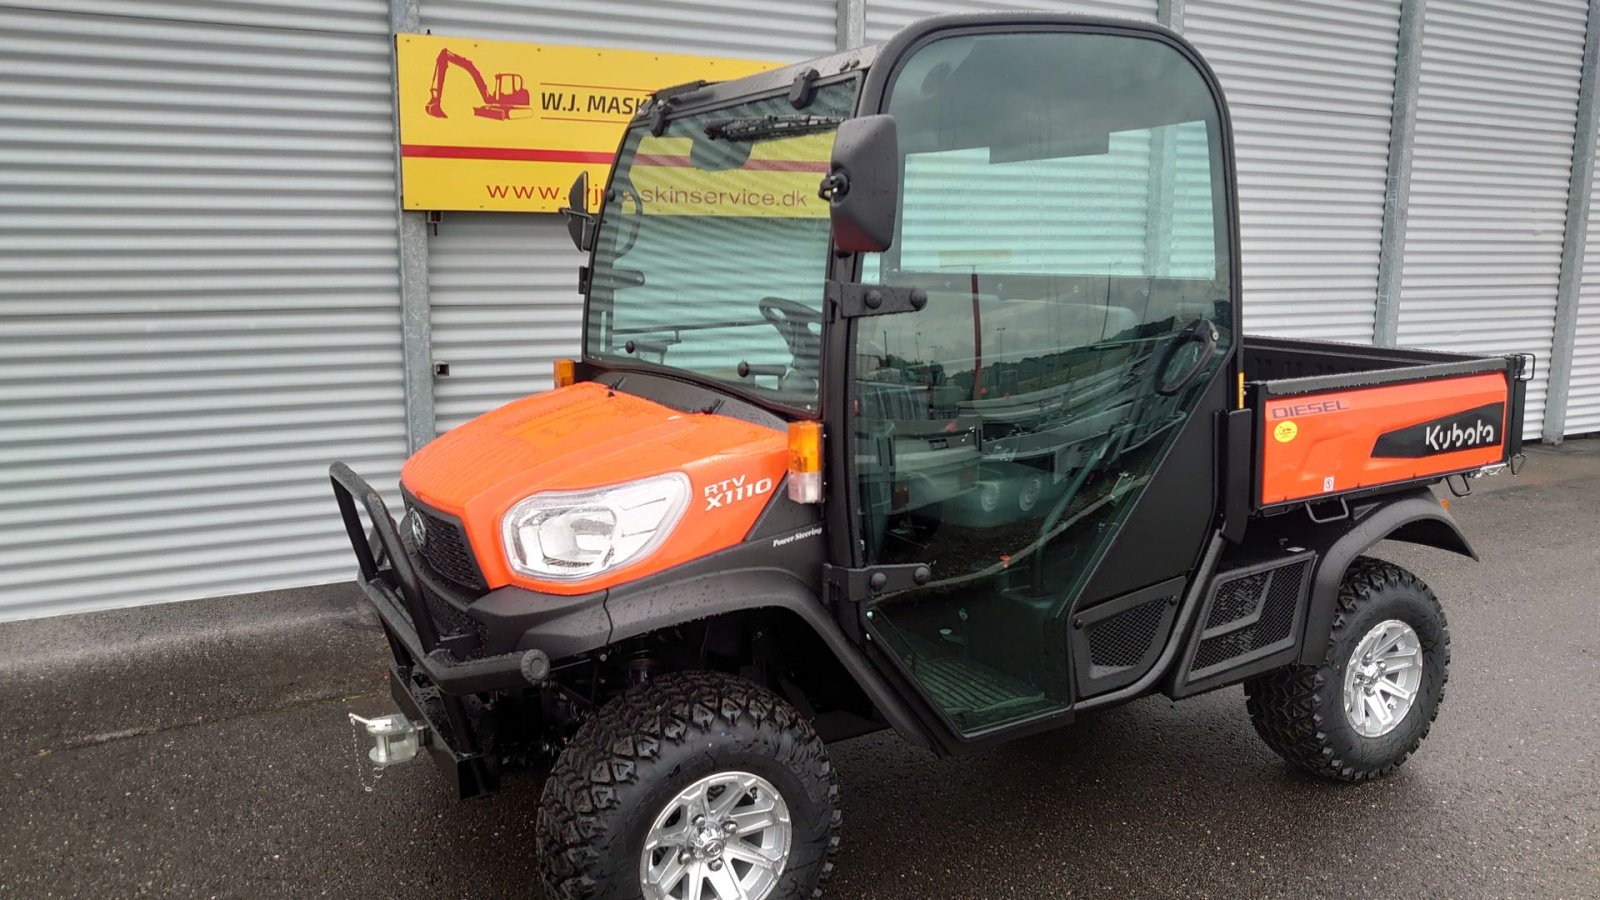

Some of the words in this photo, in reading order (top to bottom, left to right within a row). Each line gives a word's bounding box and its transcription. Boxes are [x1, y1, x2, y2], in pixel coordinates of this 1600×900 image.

[541, 92, 581, 112] W.J.
[1272, 400, 1350, 419] DIESEL
[1425, 419, 1494, 451] Kubota
[704, 474, 746, 498] RTV
[704, 477, 772, 512] X1110
[772, 535, 795, 548] Power
[794, 527, 823, 541] Steering
